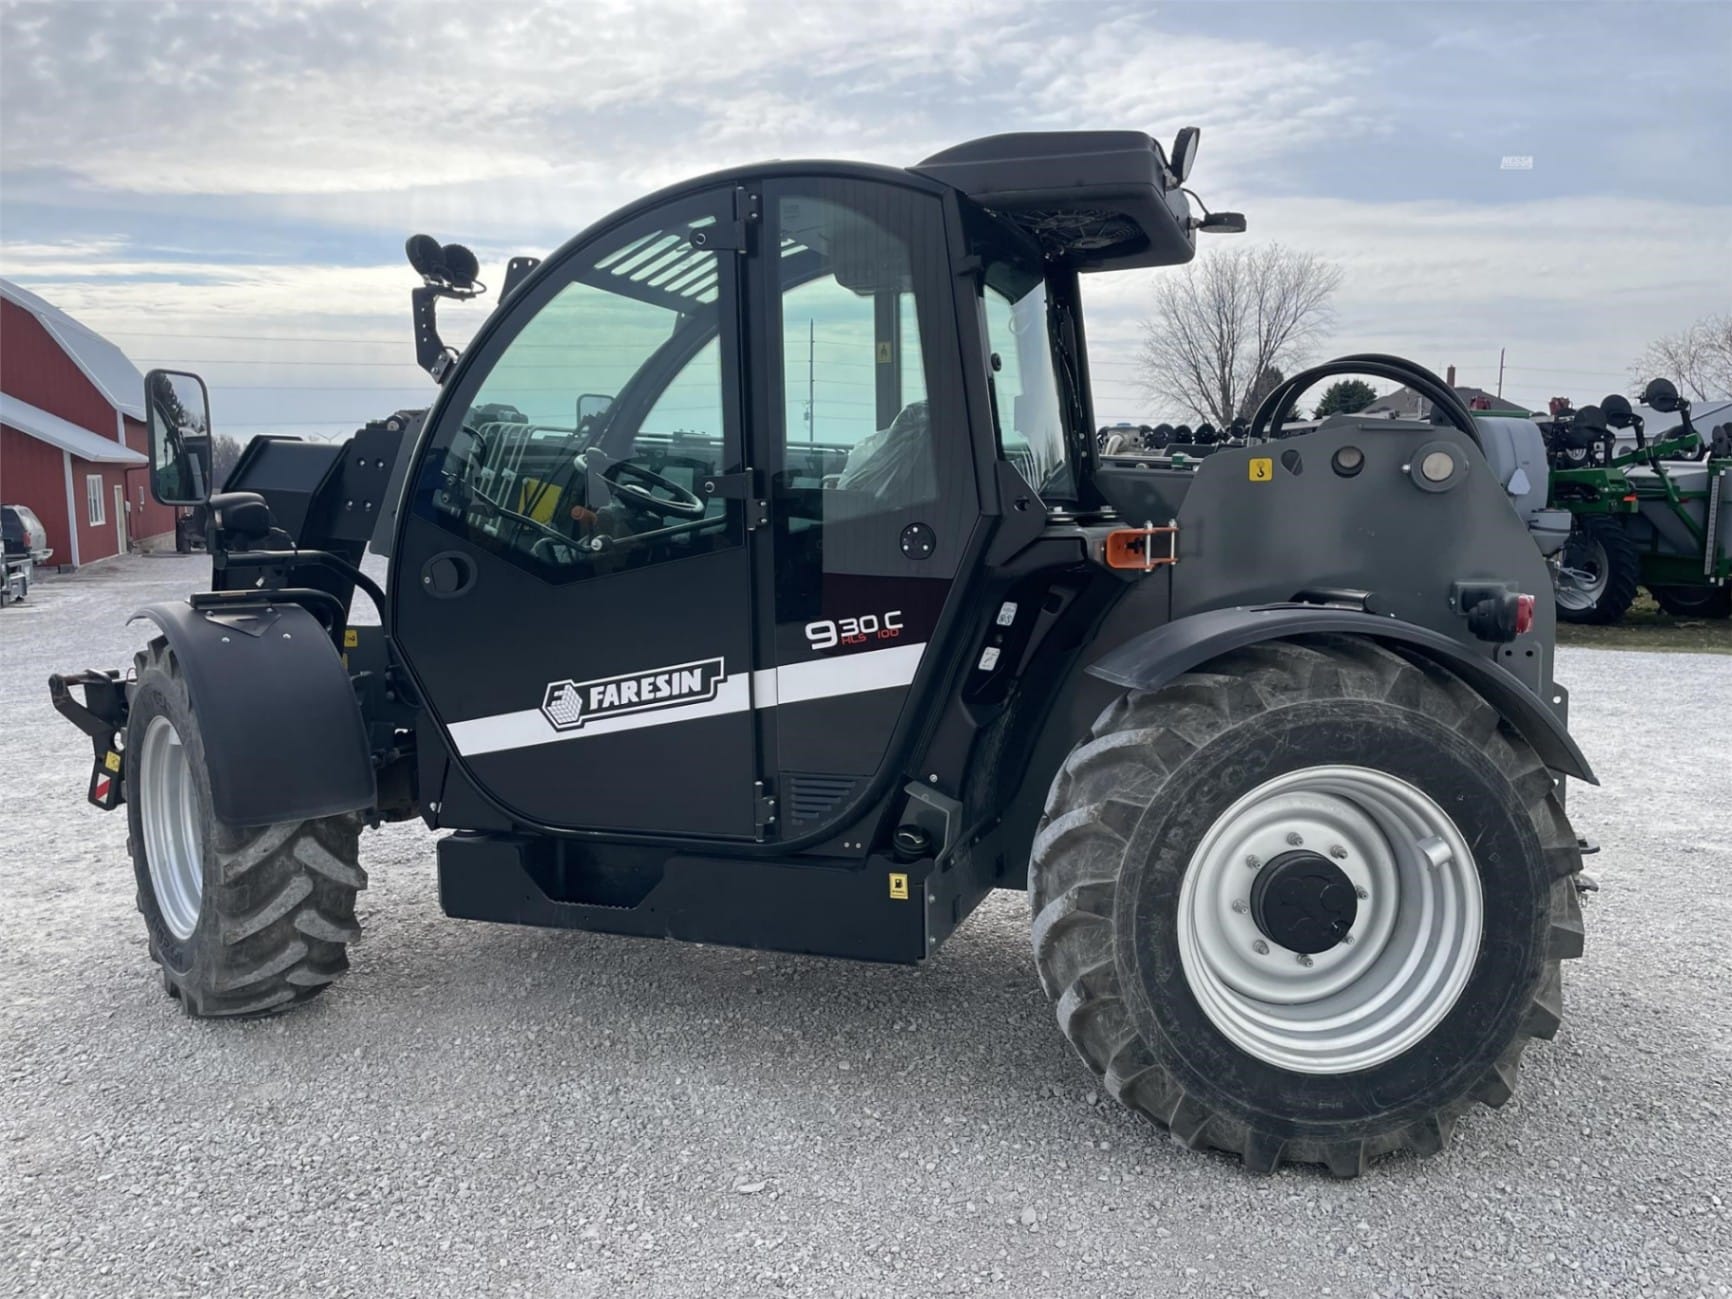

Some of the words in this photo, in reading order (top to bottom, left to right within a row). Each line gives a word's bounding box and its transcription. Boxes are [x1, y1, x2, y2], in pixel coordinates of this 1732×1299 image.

[804, 614, 879, 650] 930
[884, 610, 904, 630] C
[589, 668, 702, 711] FARESIN
